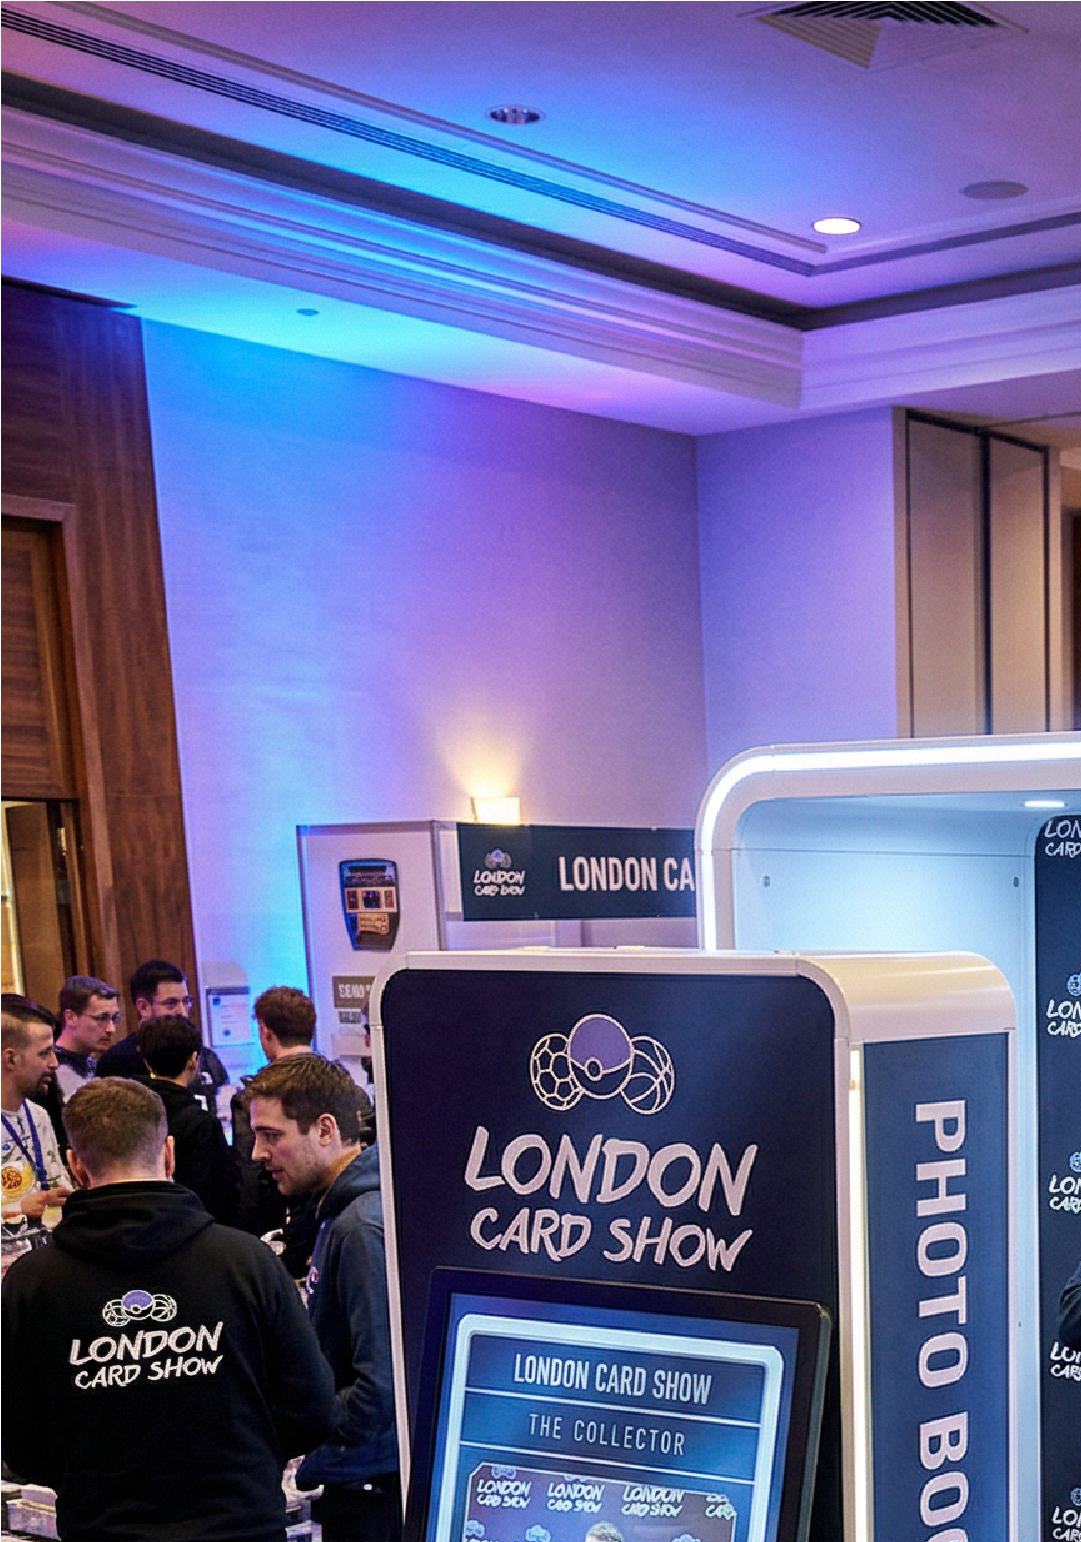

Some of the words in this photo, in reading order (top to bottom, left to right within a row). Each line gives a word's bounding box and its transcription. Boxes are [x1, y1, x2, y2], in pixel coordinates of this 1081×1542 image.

[559, 856, 657, 891] LONDON
[664, 857, 695, 891] CA
[464, 1126, 757, 1216] LONDON
[470, 1207, 591, 1262] CARD
[603, 1216, 752, 1271] SHOW
[915, 1099, 969, 1389] PHOTO
[68, 1321, 223, 1365] LONDON
[75, 1364, 140, 1389] CARD
[147, 1355, 223, 1381] SHOW
[514, 1354, 589, 1390] LONDON
[595, 1364, 646, 1396] CARD
[652, 1370, 712, 1405] SHOW
[530, 1414, 562, 1439] THE
[574, 1420, 685, 1456] COLLECTOR
